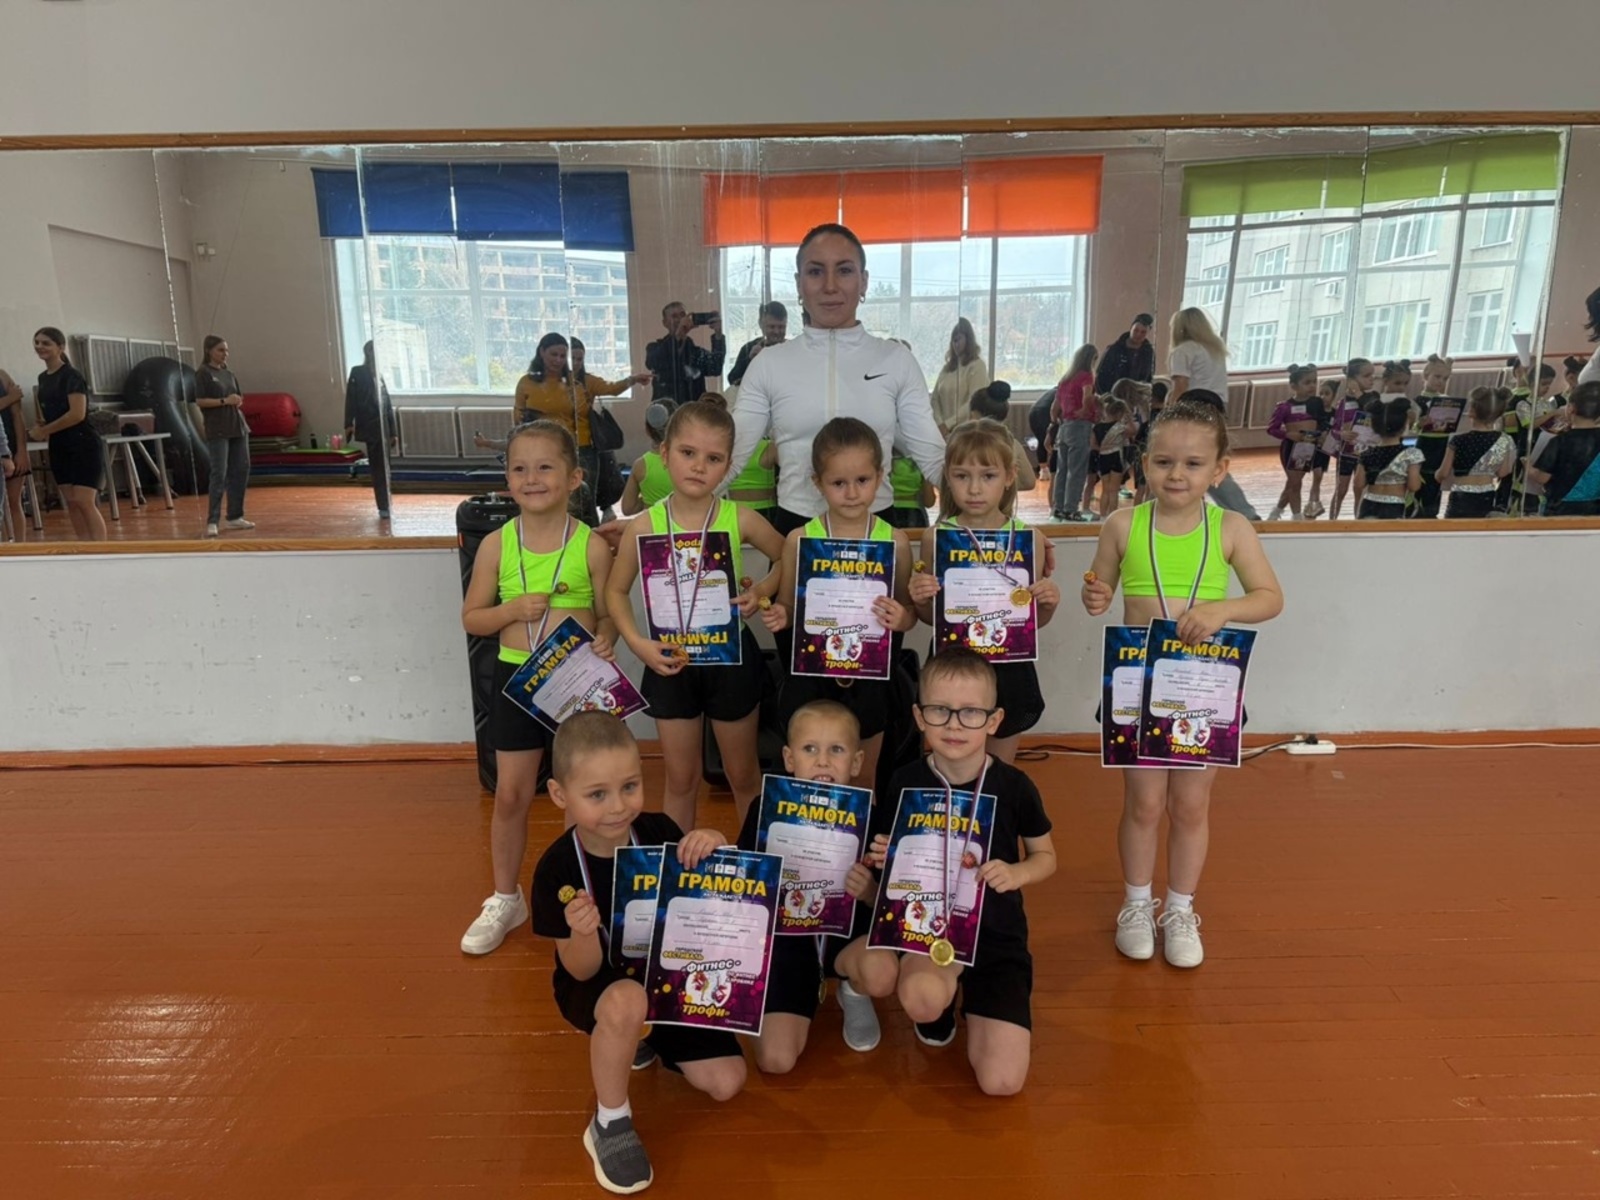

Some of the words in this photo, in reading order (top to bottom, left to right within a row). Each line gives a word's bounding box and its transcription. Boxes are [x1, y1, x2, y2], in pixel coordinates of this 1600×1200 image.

[812, 558, 885, 575] ГРАМОТА
[949, 549, 1025, 563] ГРАМОА
[1162, 639, 1240, 659] ГРАМОТА
[523, 634, 581, 693] ГРАМОТА
[777, 801, 857, 826] ГРАМОТА
[908, 813, 981, 835] ГРАМОТА
[678, 872, 767, 897] ГРАМОТА
[902, 931, 935, 945] троф
